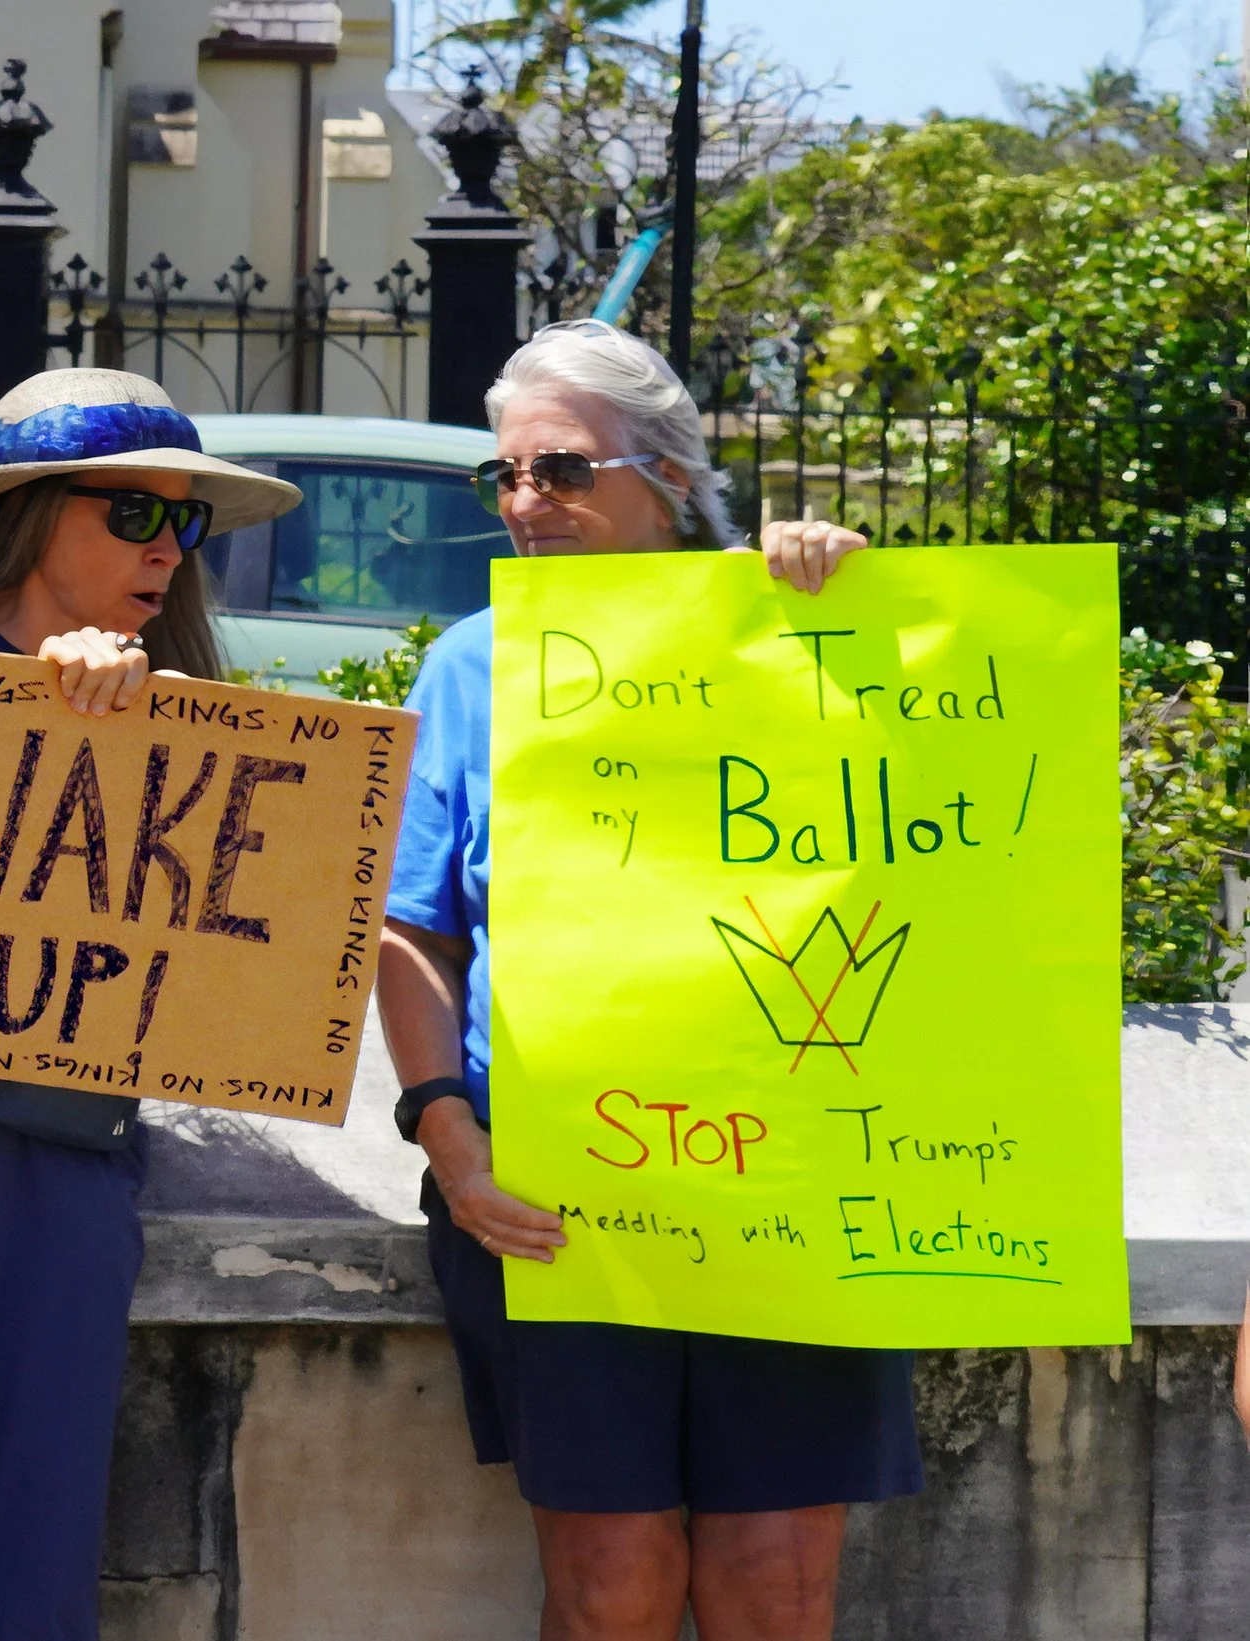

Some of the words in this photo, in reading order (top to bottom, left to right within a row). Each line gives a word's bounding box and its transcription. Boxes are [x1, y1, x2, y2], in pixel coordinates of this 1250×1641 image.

[541, 631, 713, 719] Don't
[779, 630, 1004, 720] Tread
[290, 715, 339, 744] NO
[594, 757, 637, 779] on
[592, 809, 638, 867] my
[355, 847, 377, 884] NO
[326, 1019, 351, 1054] NO
[161, 1073, 203, 1094] NO
[592, 1090, 767, 1174] STOP
[825, 1105, 1018, 1184] Trump's
[558, 1204, 706, 1264] Meddling
[742, 1215, 806, 1248] with
[839, 1196, 1048, 1266] Elections
